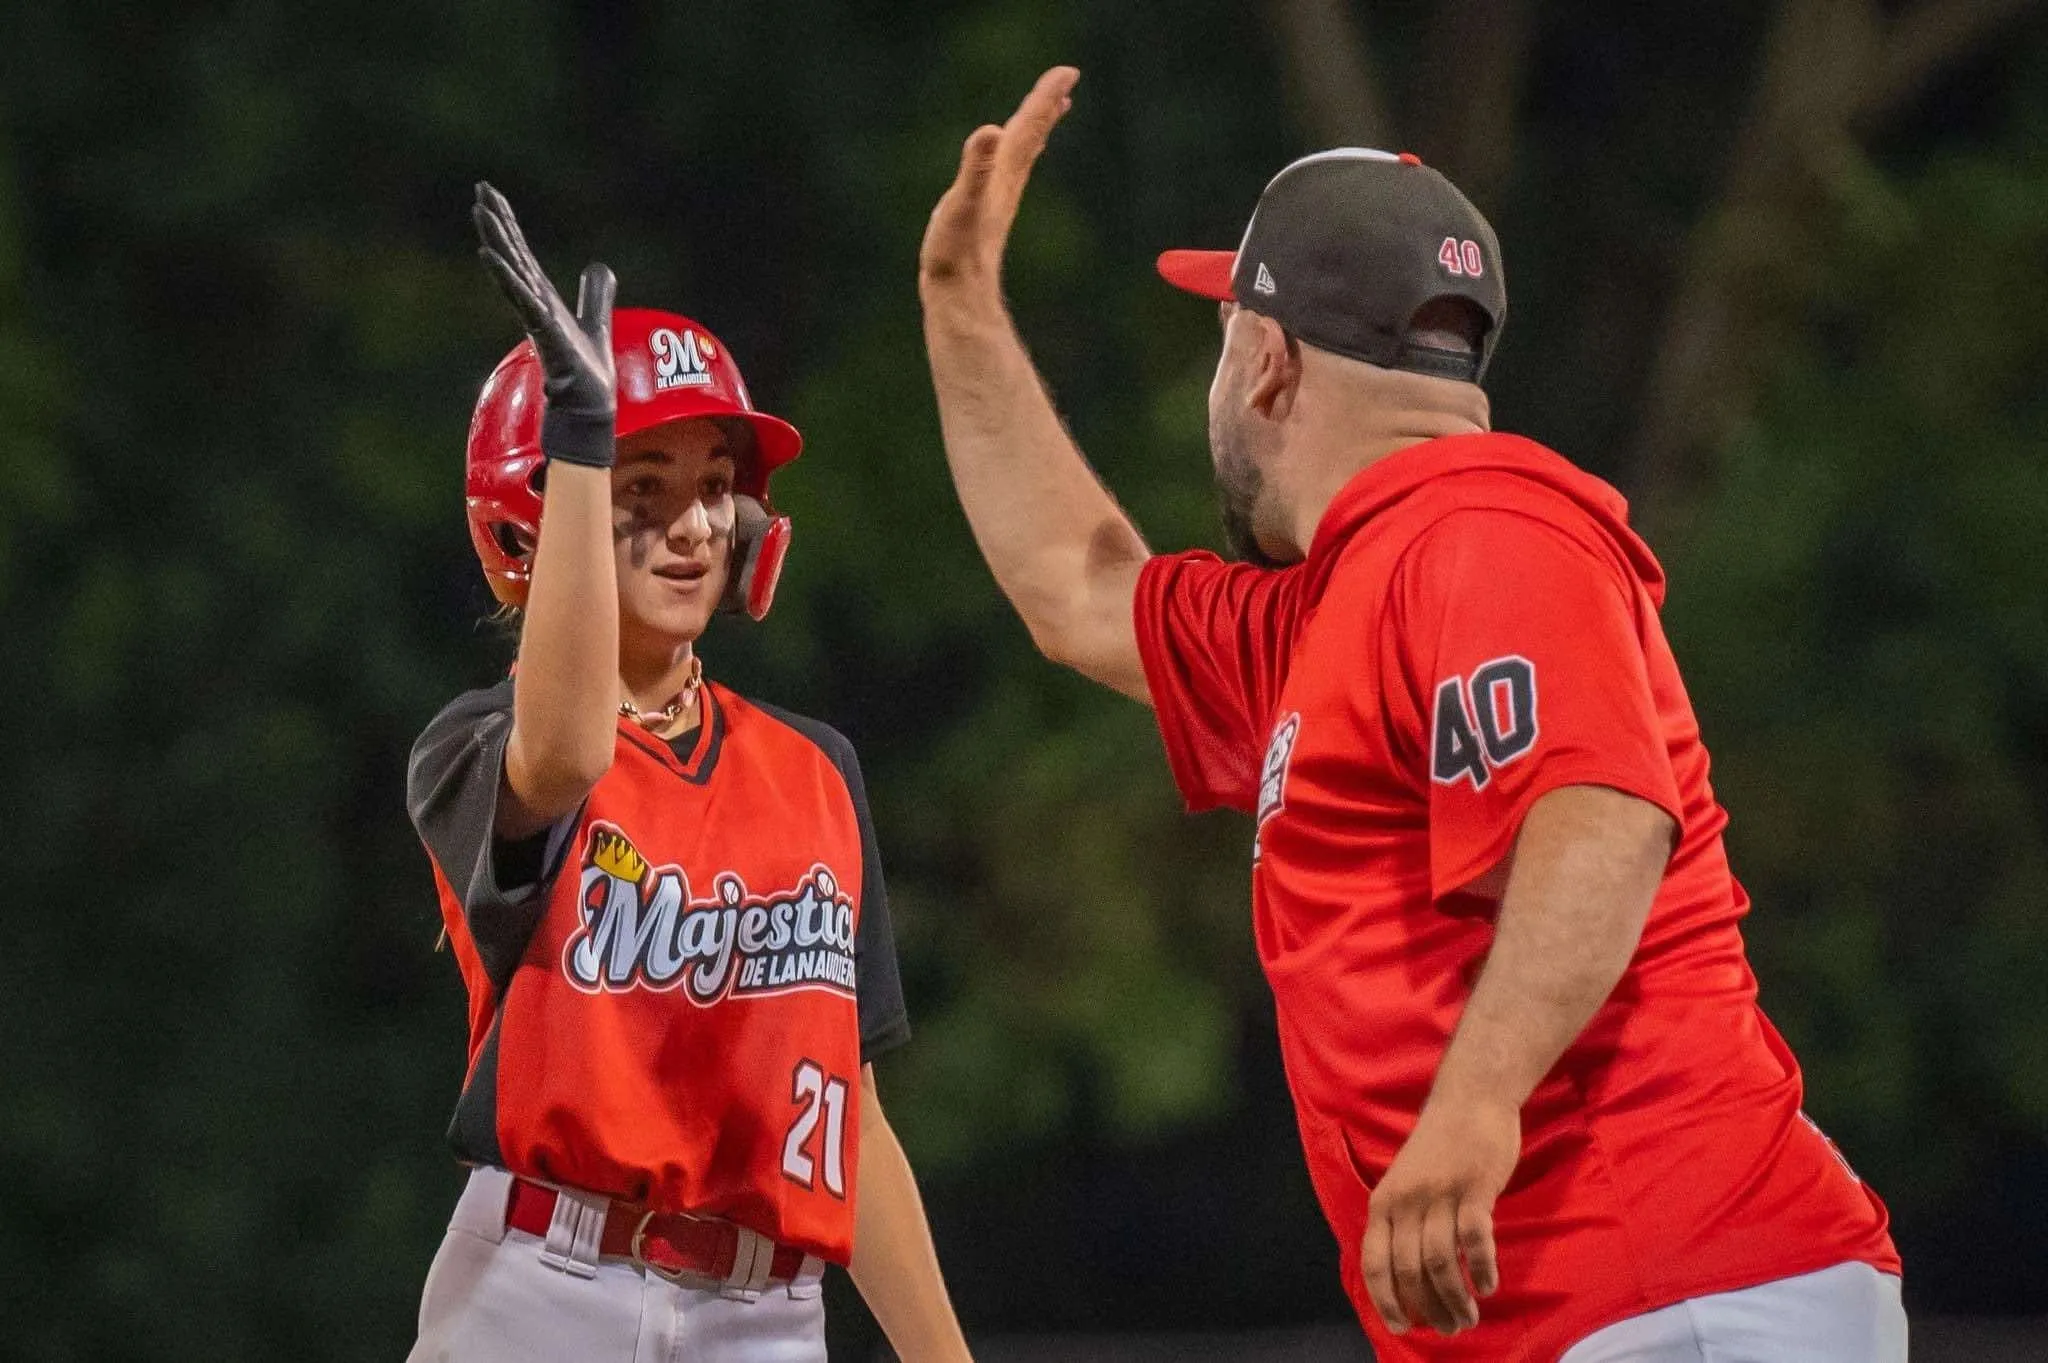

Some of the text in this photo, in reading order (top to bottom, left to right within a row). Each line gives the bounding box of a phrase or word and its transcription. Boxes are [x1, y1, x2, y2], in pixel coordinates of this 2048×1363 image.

[1438, 236, 1483, 277] 40
[650, 328, 706, 377] M
[657, 376, 668, 389] DE
[1430, 655, 1539, 792] 40
[573, 866, 856, 997] Majestic
[739, 956, 767, 988] DE
[782, 1058, 848, 1199] 21
